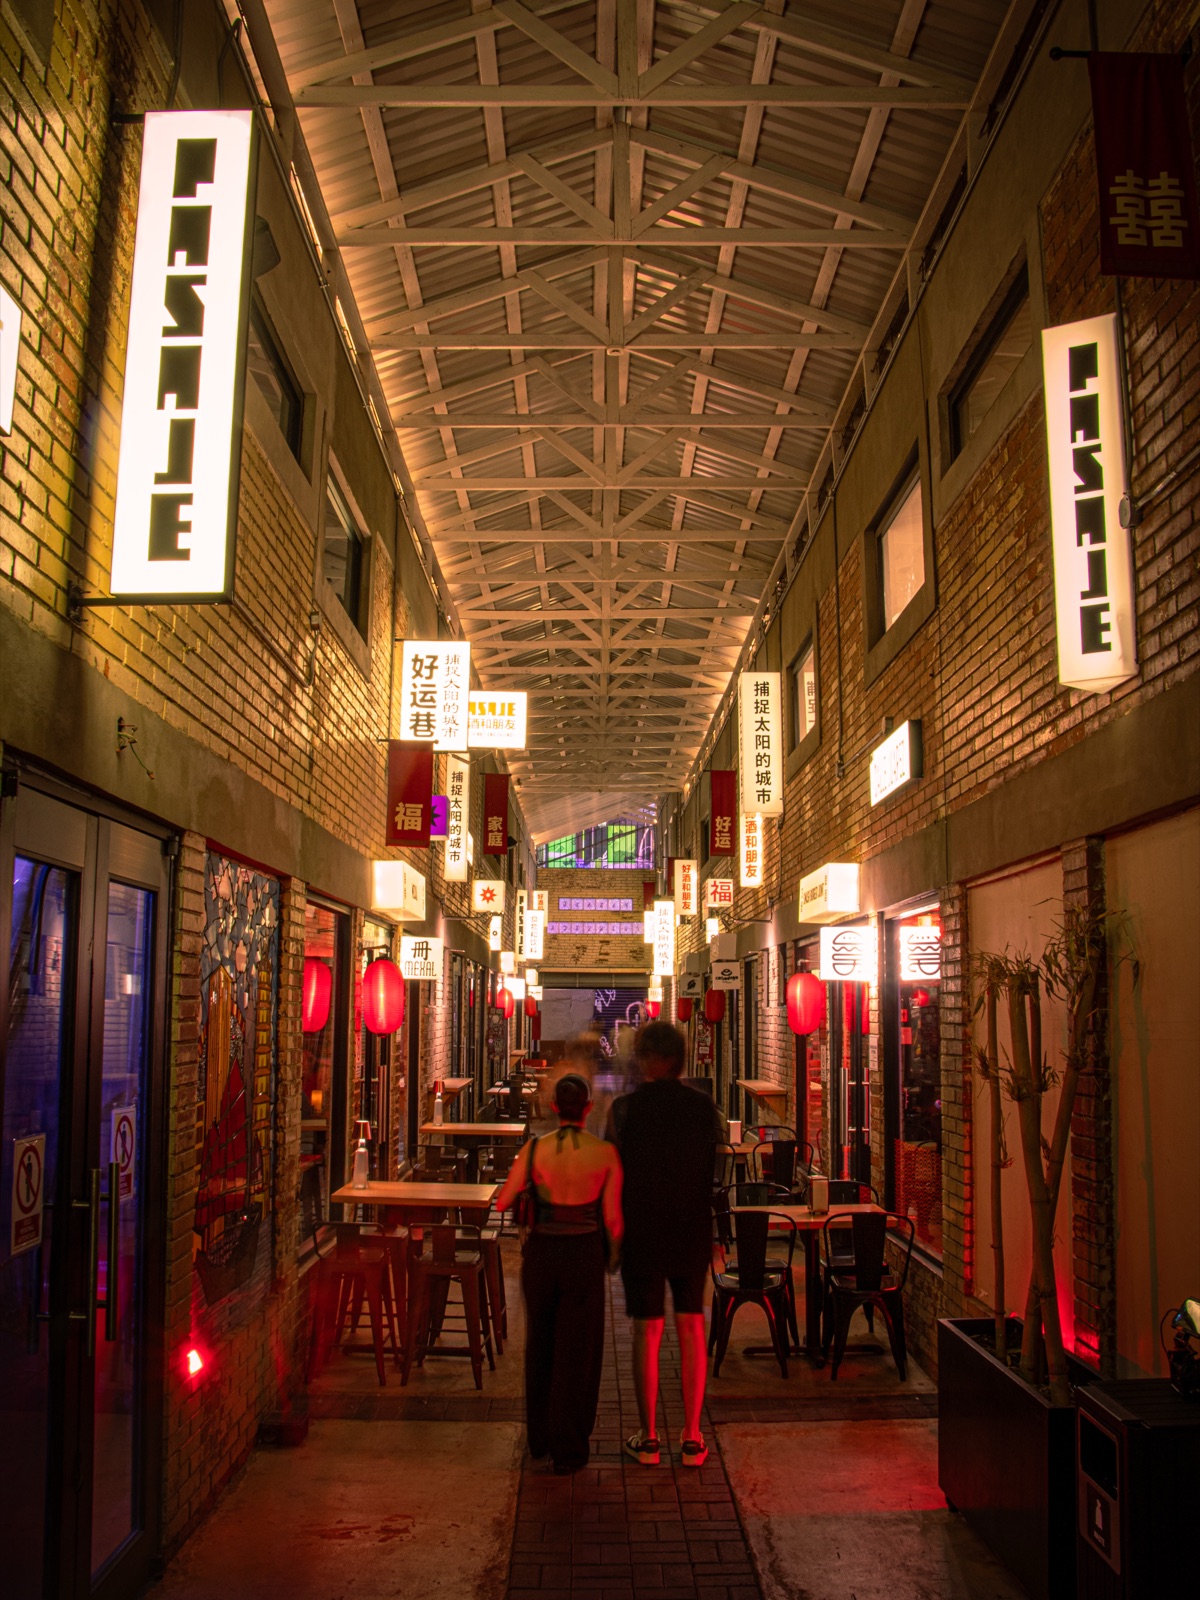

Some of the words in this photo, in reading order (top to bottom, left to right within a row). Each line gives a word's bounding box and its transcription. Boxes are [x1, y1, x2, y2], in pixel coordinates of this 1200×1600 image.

[148, 138, 217, 561] PASAJE
[1068, 341, 1112, 655] PASAJE
[409, 653, 439, 738] 好运巷
[442, 654, 461, 738] 捕捉太阳的城市
[468, 701, 516, 717] ASAJE
[468, 718, 516, 730] 酒和朋友
[753, 680, 772, 805] 捕捉太阳的城市
[394, 801, 424, 832] 福
[449, 770, 464, 863] 捕捉太阳的城市
[487, 815, 504, 848] 家庭
[714, 815, 732, 849] 好运
[681, 863, 692, 911] 好酒和朋友
[710, 880, 733, 903] 福
[404, 960, 437, 977] MEXAL
